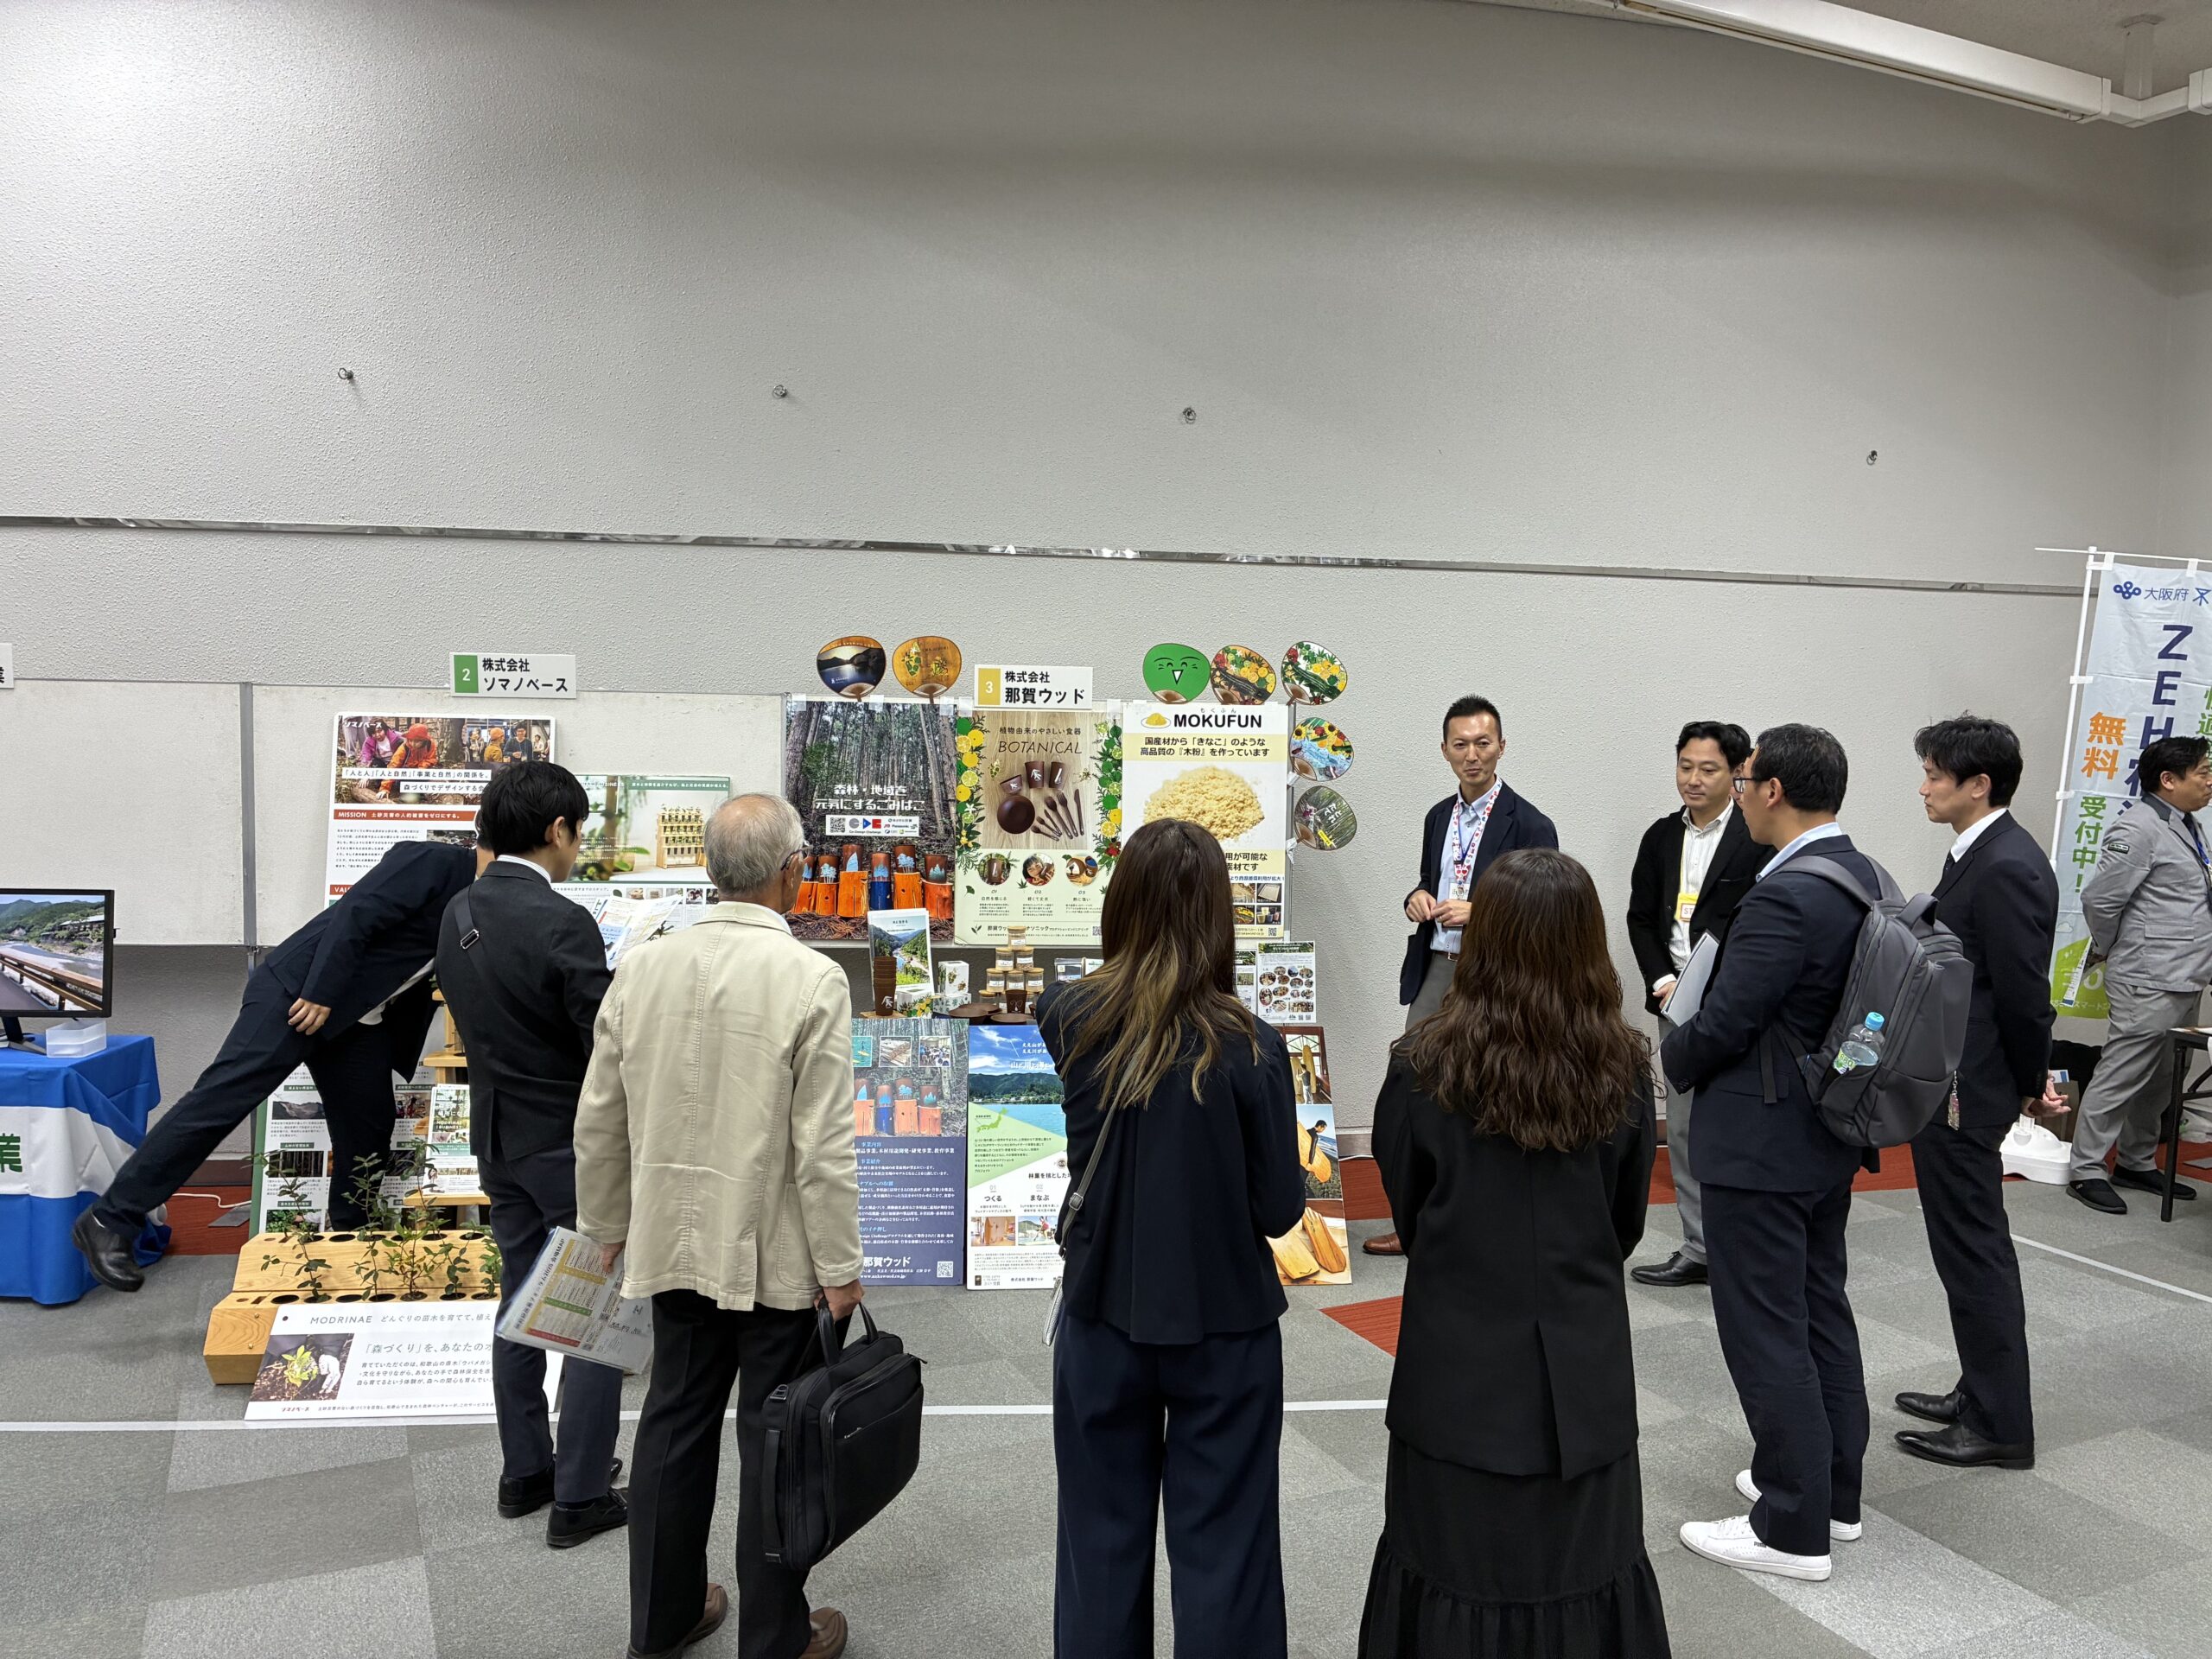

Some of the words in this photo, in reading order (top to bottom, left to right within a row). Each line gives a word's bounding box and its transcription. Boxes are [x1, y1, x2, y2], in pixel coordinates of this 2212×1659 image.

[2144, 588, 2190, 601] 大阪府
[482, 658, 531, 672] 株式会社
[461, 668, 471, 682] 2
[1004, 671, 1051, 683] 株式会社
[484, 677, 569, 692] ソマノベース
[985, 681, 994, 694] 3
[1005, 687, 1085, 704] 那賀ウッド
[1173, 714, 1262, 728] MOKUFUN
[999, 727, 1082, 735] 植物由来のやさしい食器
[998, 741, 1083, 754] BOTANICAL
[1144, 737, 1266, 747] 国産材から「きなこ」のような
[2081, 711, 2127, 780] 無料
[1140, 747, 1270, 757] 高品質の『木粉』を作っています
[834, 784, 908, 797] 森林・地域を
[863, 1256, 912, 1268] 那賀ウッド
[309, 1315, 373, 1325] MODRINAE
[380, 1313, 492, 1323] どんぐりの苗木を育てて、植え
